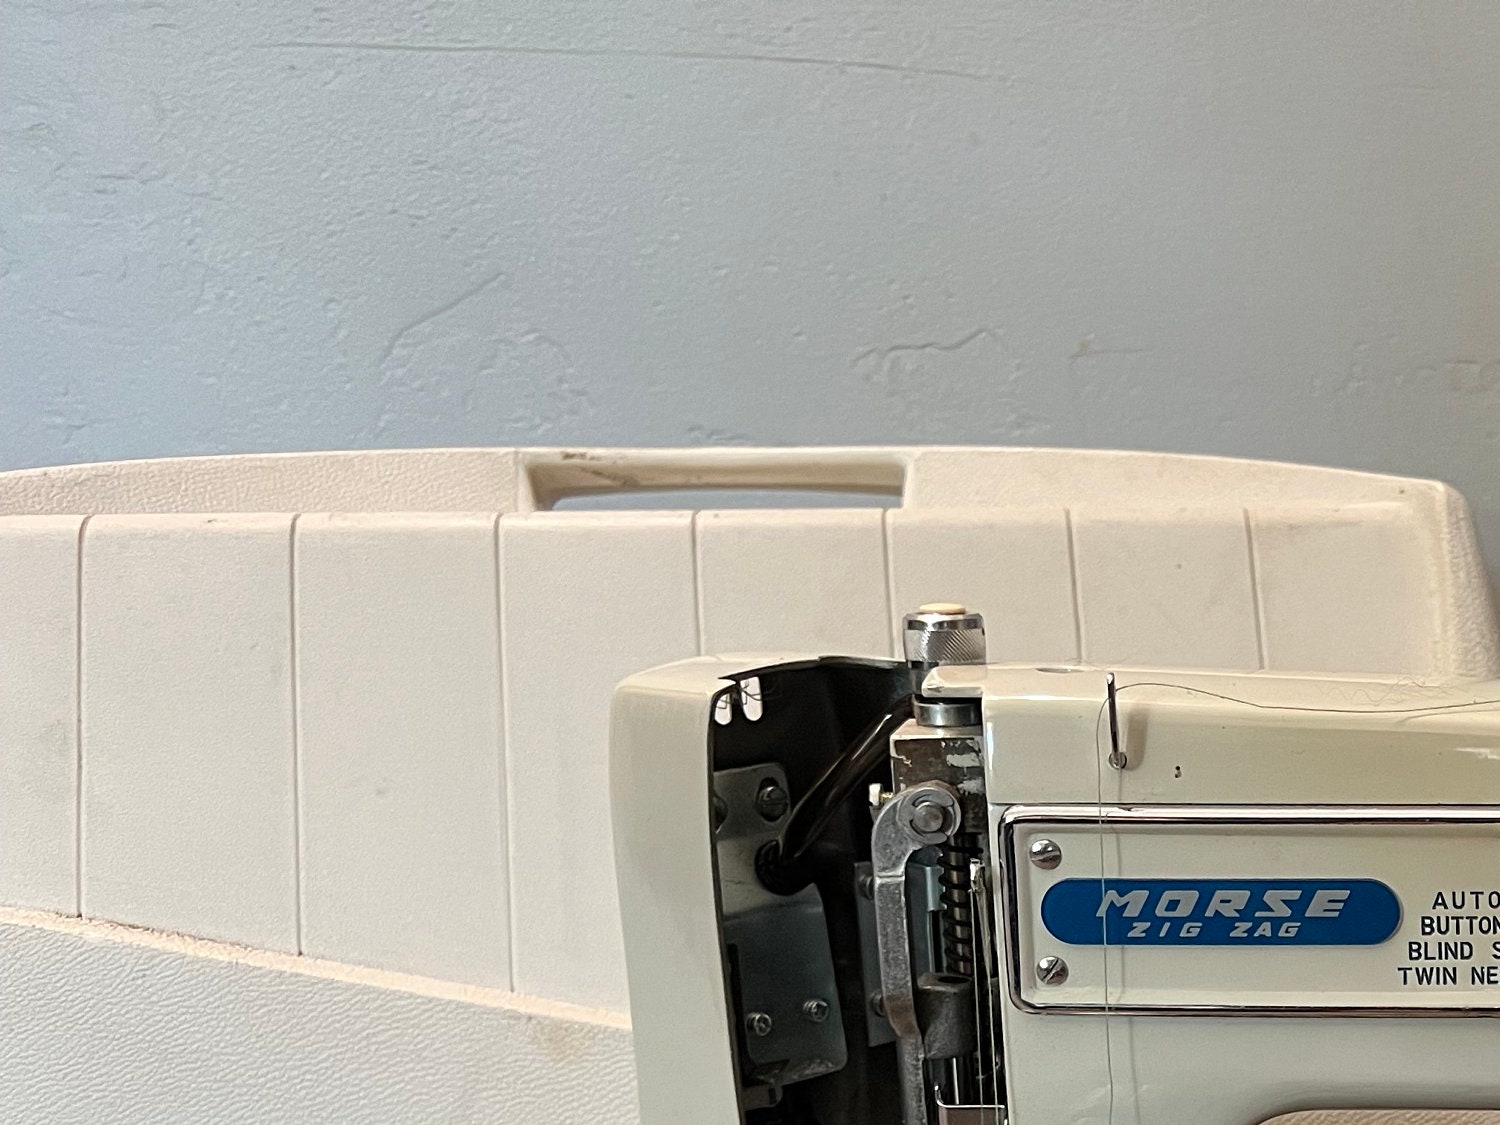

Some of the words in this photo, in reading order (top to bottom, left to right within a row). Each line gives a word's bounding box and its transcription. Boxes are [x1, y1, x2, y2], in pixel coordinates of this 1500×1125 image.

[1095, 889, 1351, 918] MORSE
[1127, 922, 1203, 938] ZIG
[1229, 922, 1301, 938] ZAG
[1408, 941, 1474, 961] BLIND
[1398, 966, 1457, 985] TWIN
